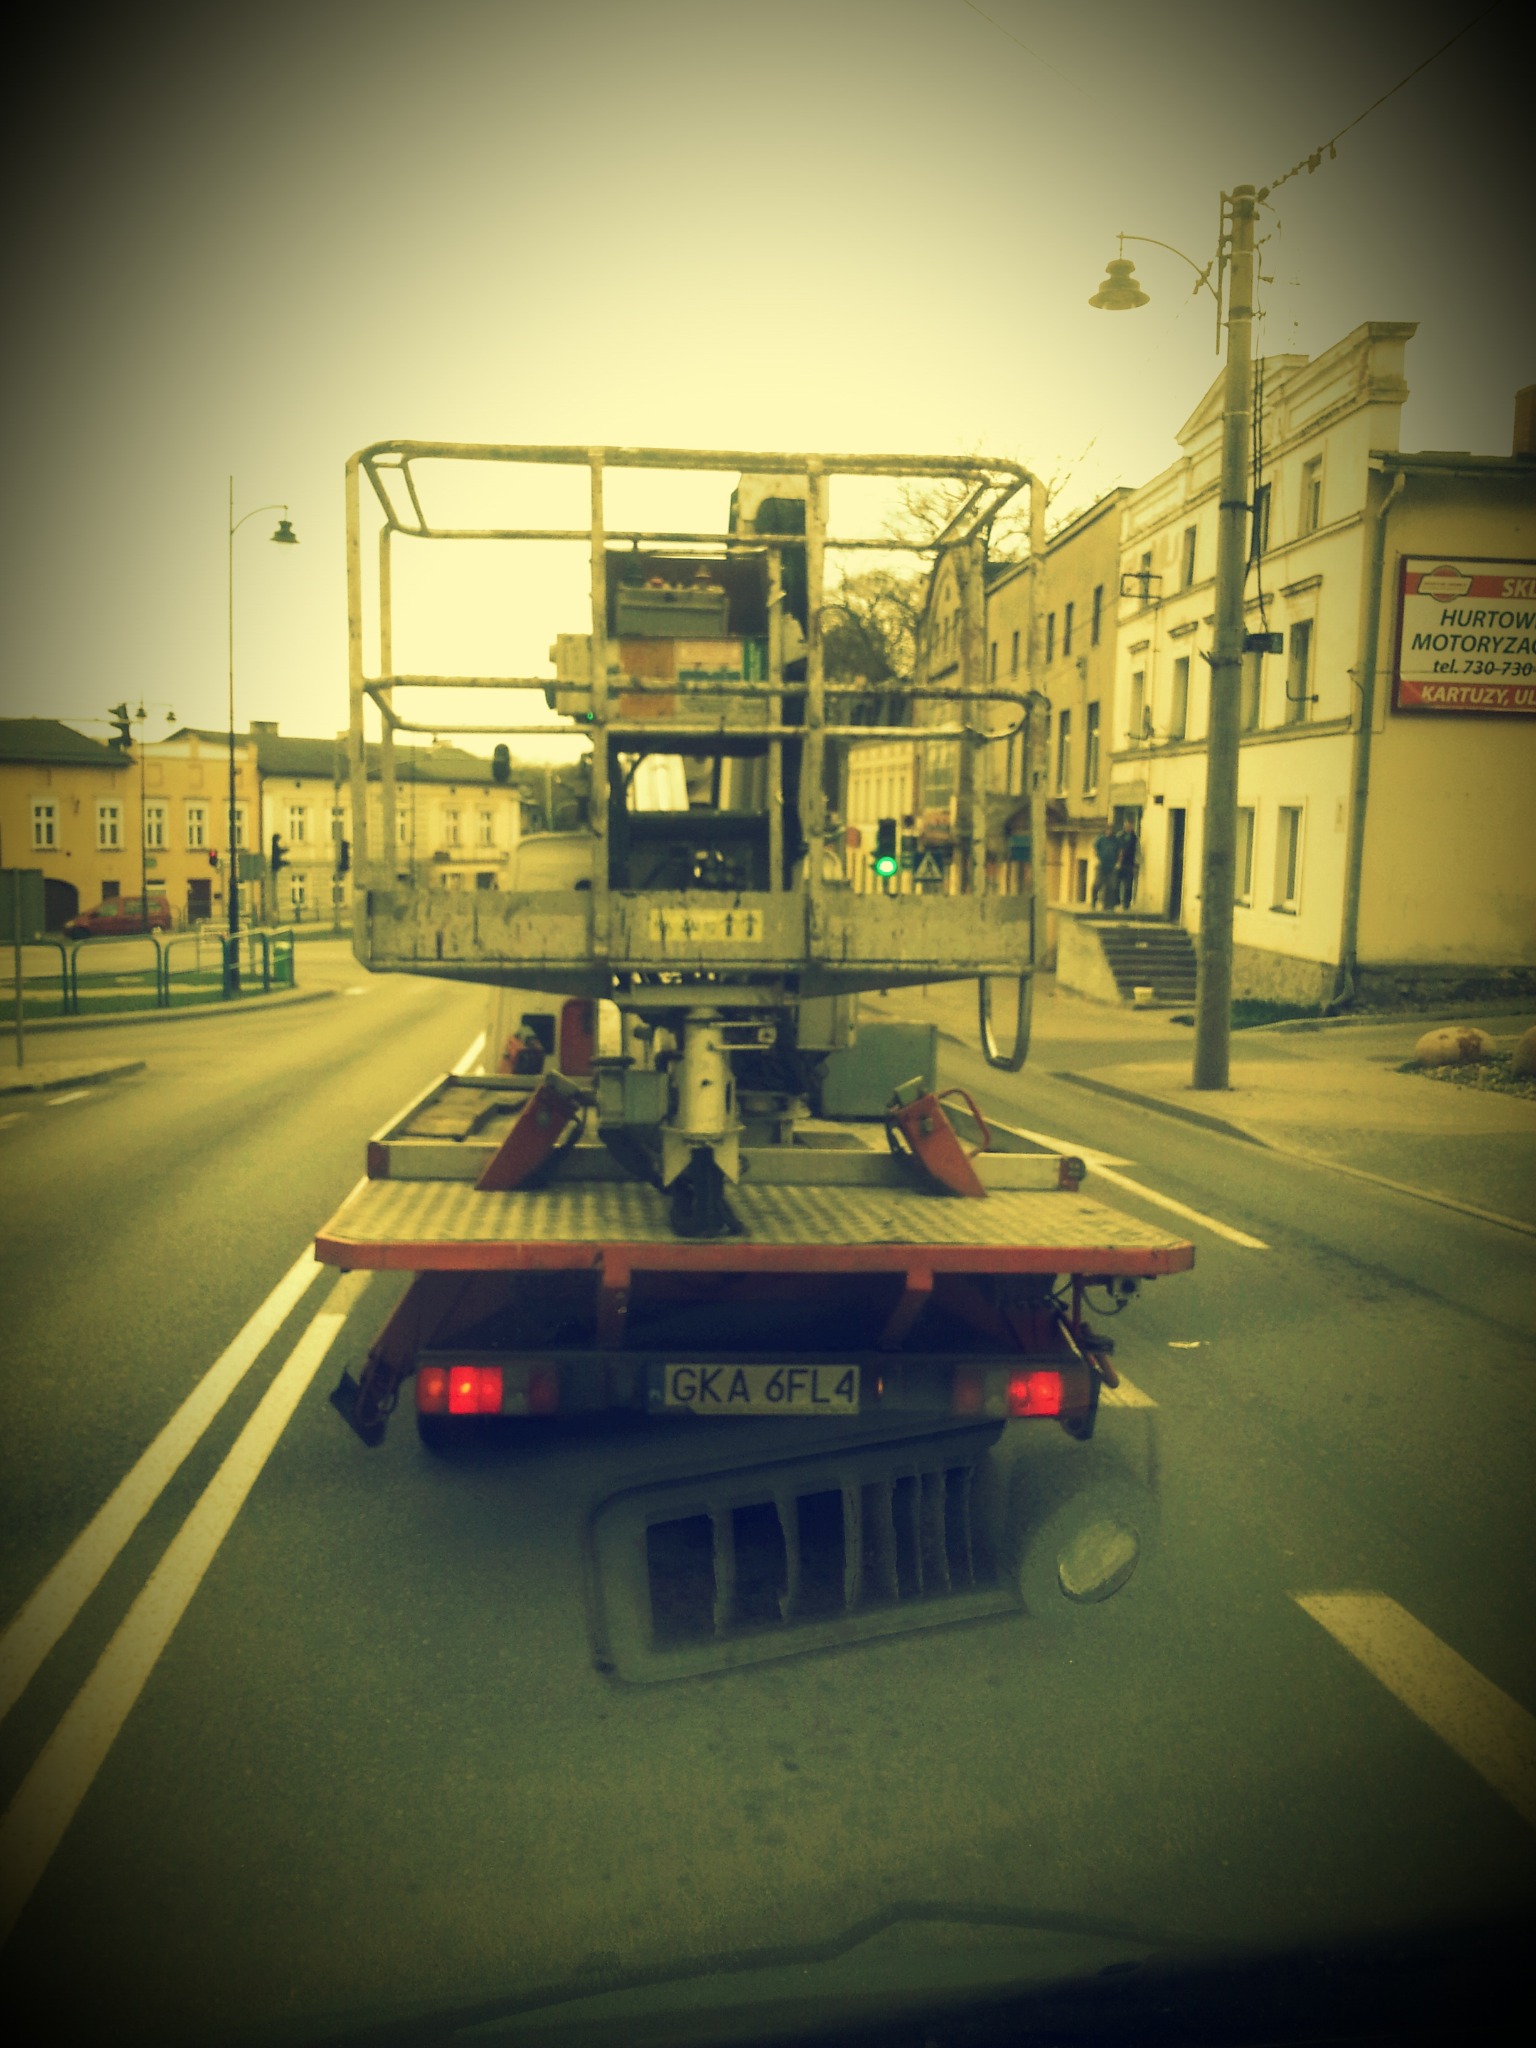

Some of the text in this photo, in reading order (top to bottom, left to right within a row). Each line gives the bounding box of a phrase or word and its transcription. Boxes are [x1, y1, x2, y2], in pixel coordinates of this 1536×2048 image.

[1440, 609, 1536, 630] HURTOW
[1433, 659, 1458, 674] tel.
[1421, 686, 1508, 706] KARTUZY,
[672, 1368, 856, 1404] GKA 6FL4
